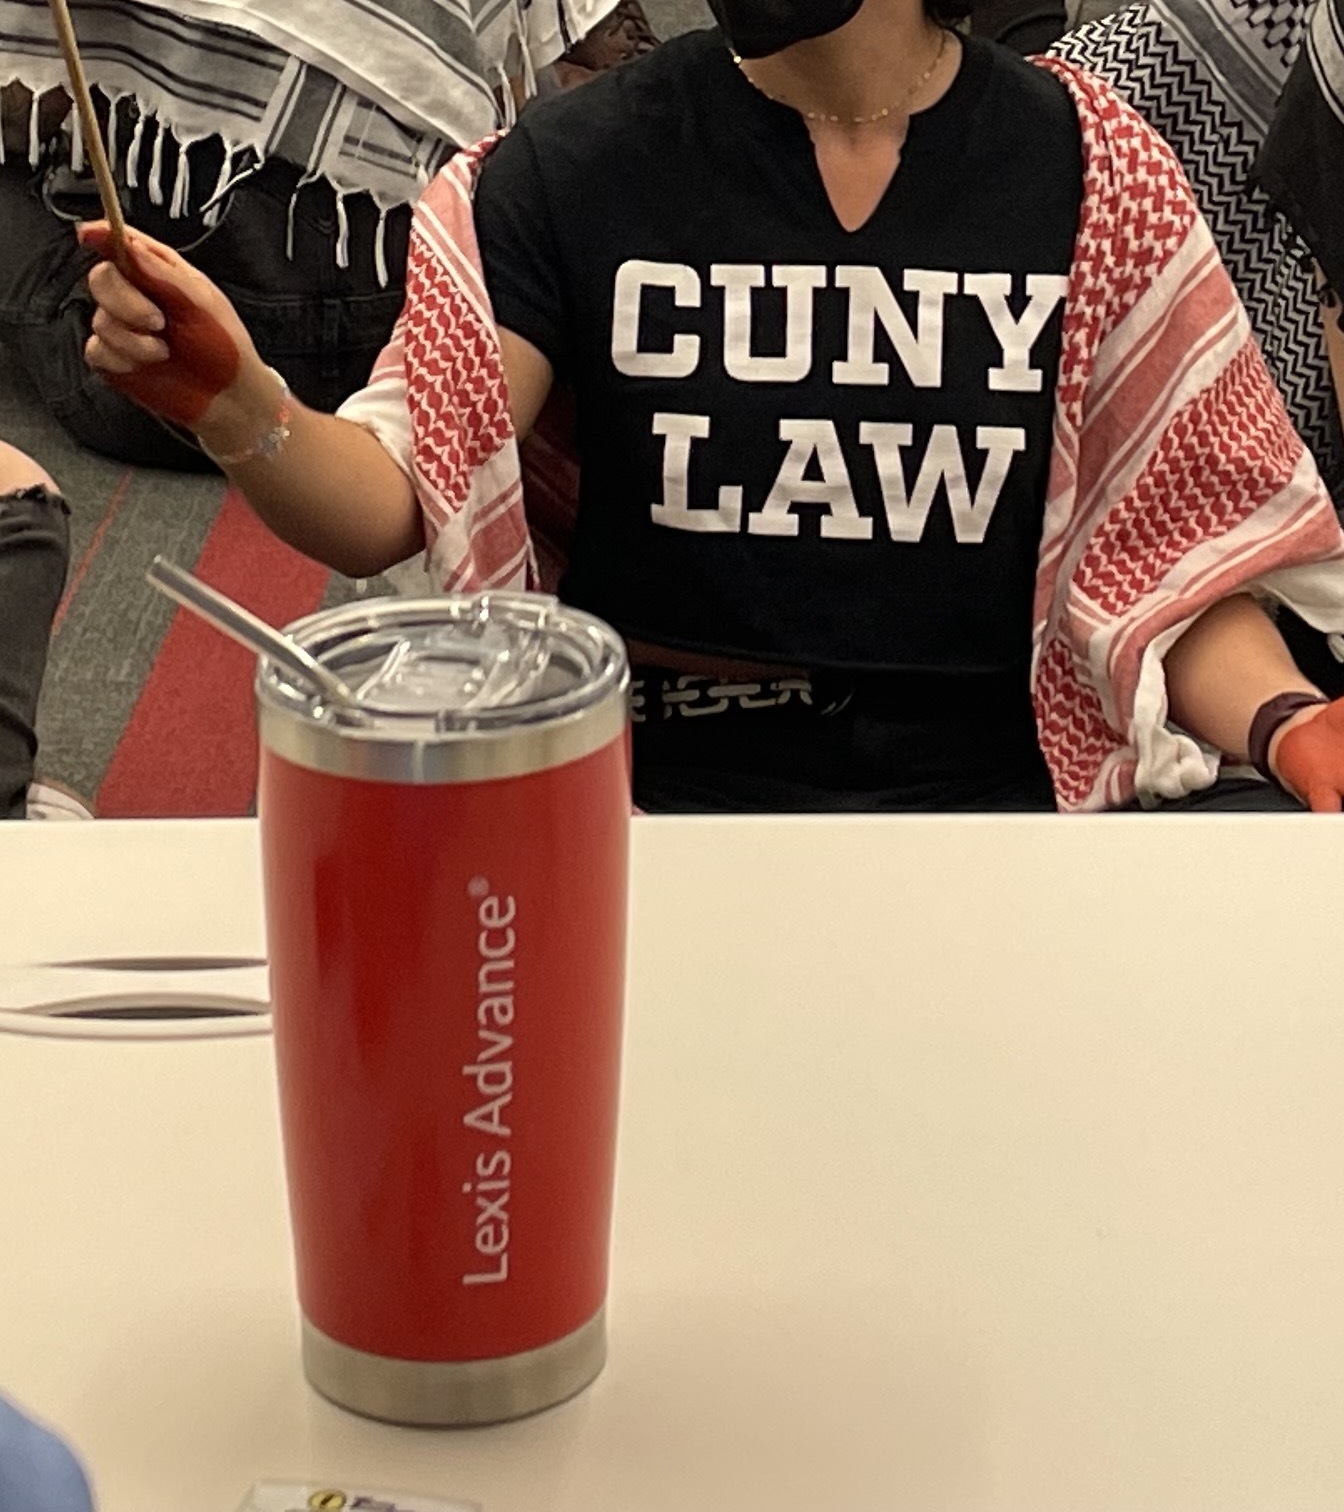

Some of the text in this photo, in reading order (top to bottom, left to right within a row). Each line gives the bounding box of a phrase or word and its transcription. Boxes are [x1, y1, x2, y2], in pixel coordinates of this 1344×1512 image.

[611, 259, 1069, 392] CUNY
[650, 412, 1026, 543] LAW
[462, 1149, 512, 1285] Lexis
